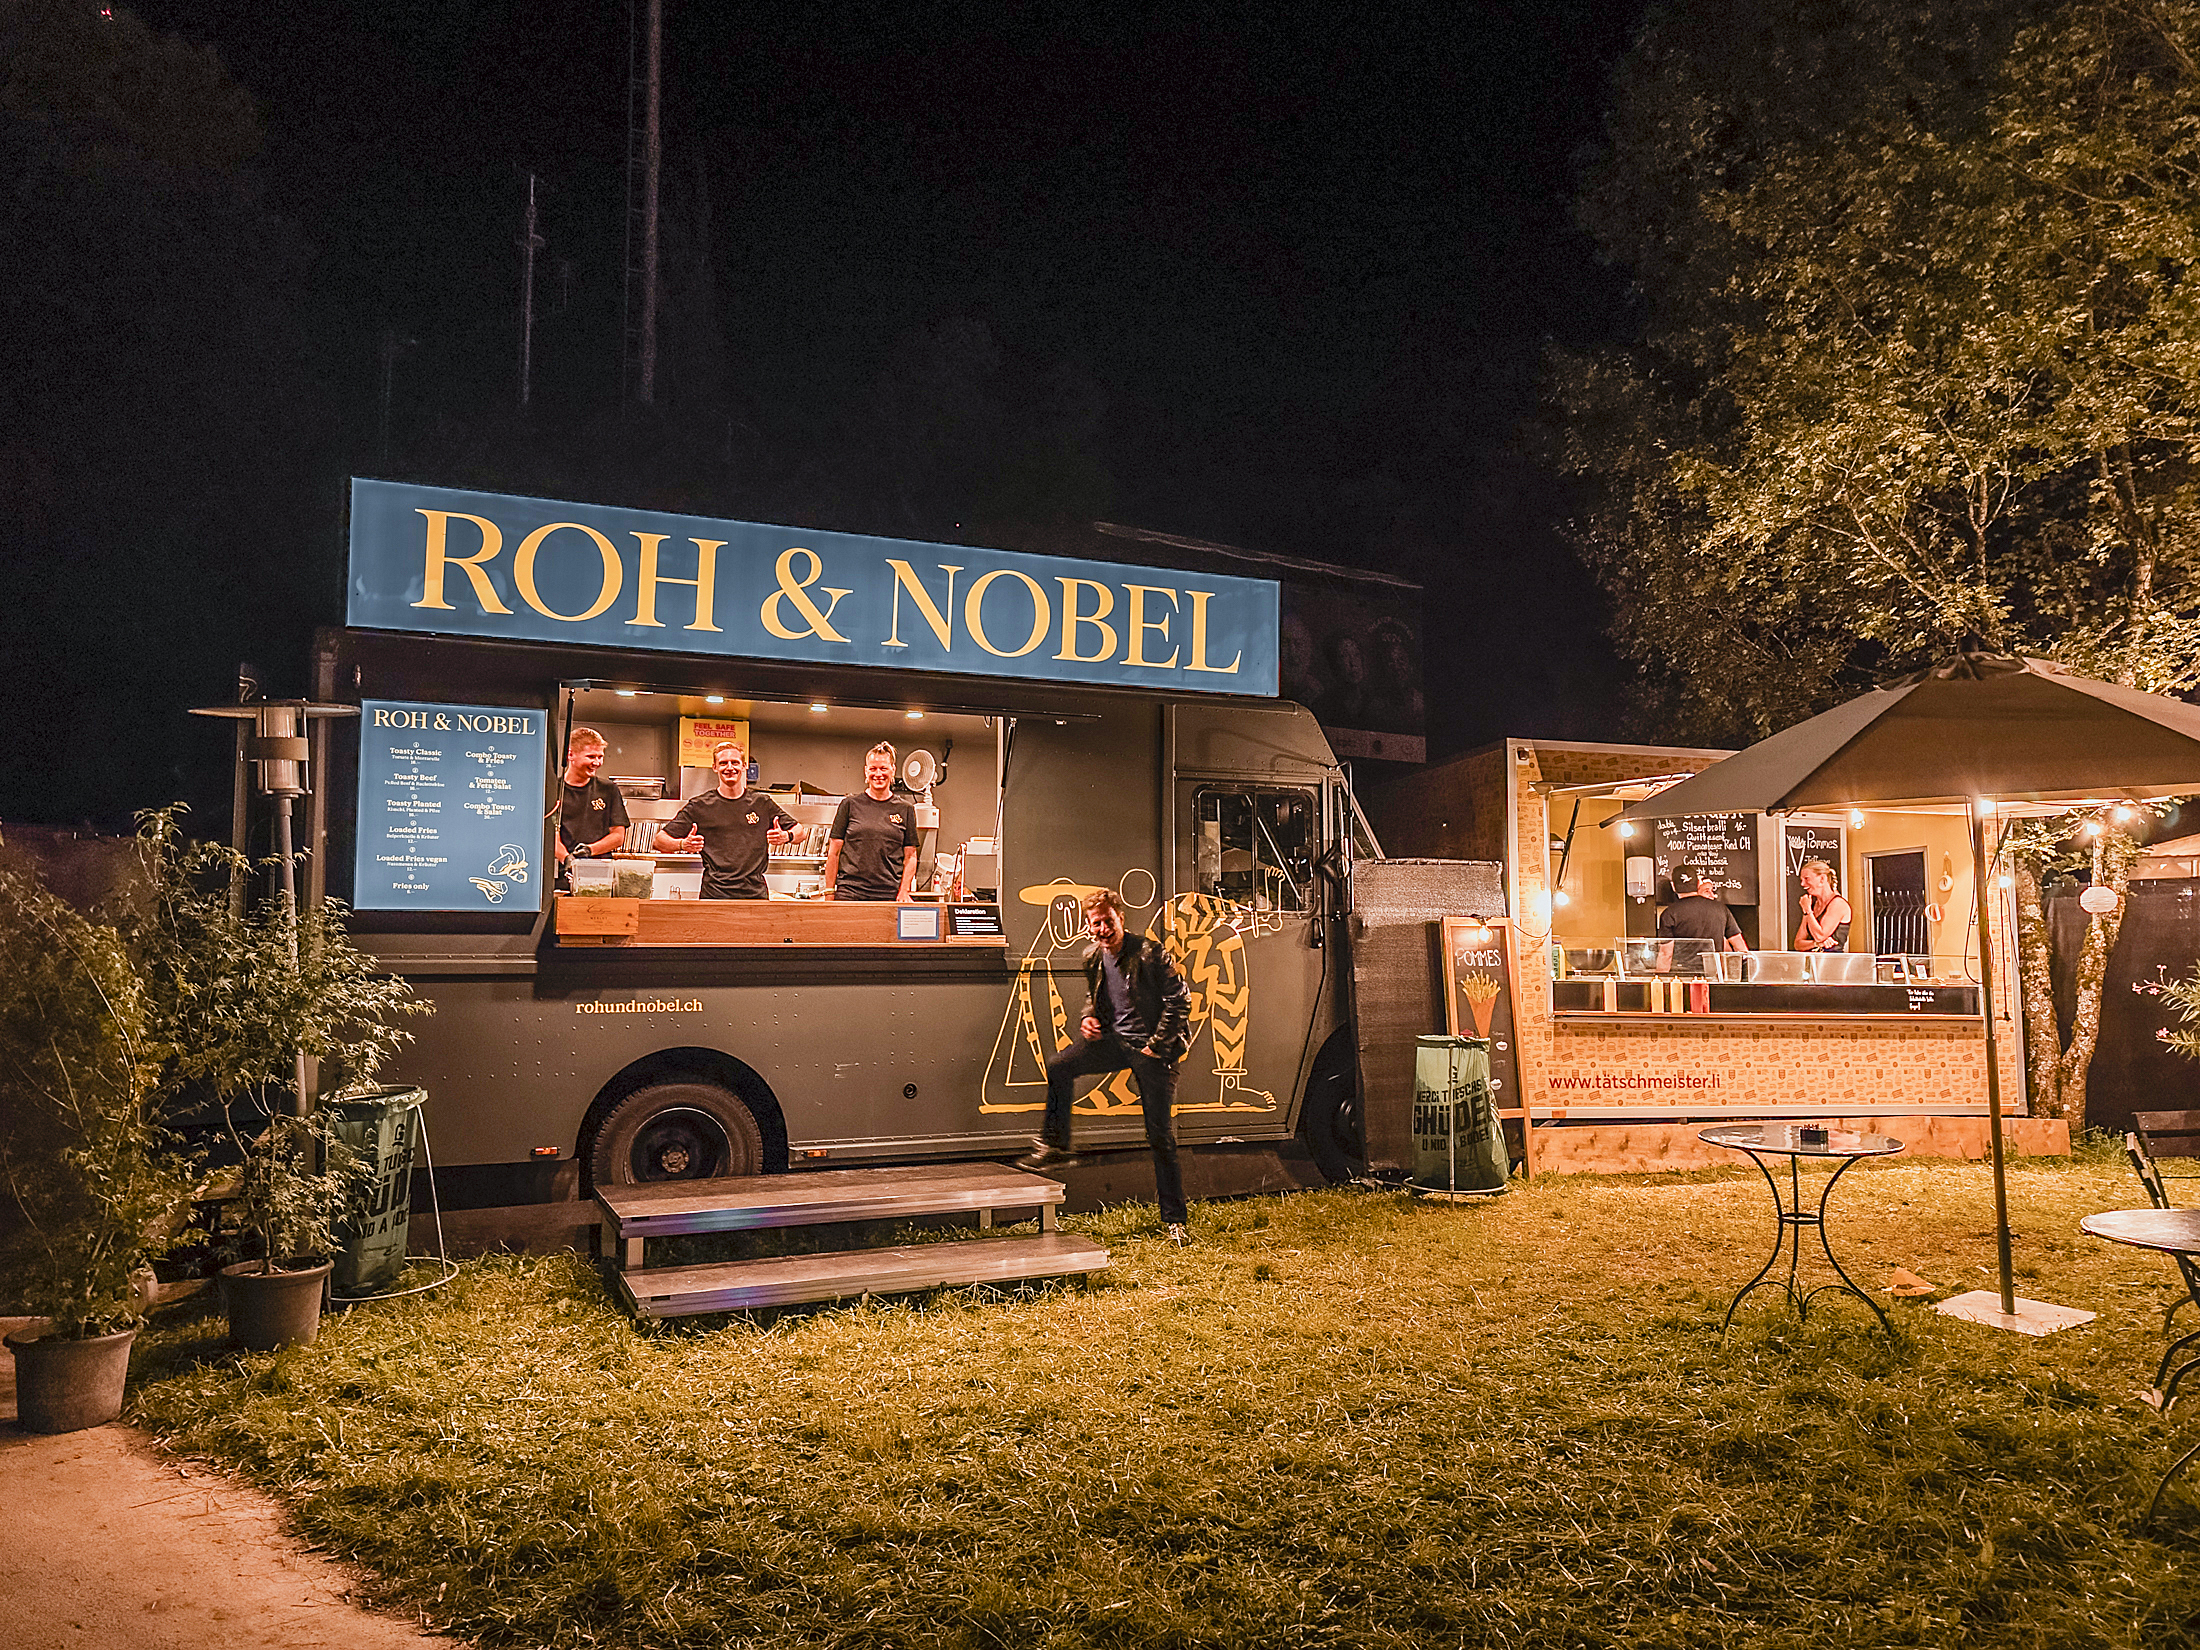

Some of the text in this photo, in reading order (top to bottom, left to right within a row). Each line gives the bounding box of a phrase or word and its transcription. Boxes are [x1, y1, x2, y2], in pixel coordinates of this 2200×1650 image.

[410, 507, 1243, 676] ROH & NOBEL
[374, 709, 536, 736] ROH & NOBEL
[694, 722, 712, 730] FEEL
[694, 730, 736, 739] TOGETHER
[390, 747, 442, 756] Toasty Classic
[493, 752, 517, 760] Toasty
[394, 773, 419, 781] Toasty
[474, 776, 507, 784] Tomaten
[386, 799, 441, 808] Toasty Planted
[491, 803, 515, 811] Toasty
[1739, 836, 1751, 850] CH
[1806, 830, 1839, 849] Pommes
[376, 854, 404, 862] Loaded
[413, 883, 430, 891] only
[1455, 948, 1501, 967] POMMES
[576, 999, 703, 1014] rohundnobel.ch
[1548, 1074, 1721, 1089] www.tätschmeister.li
